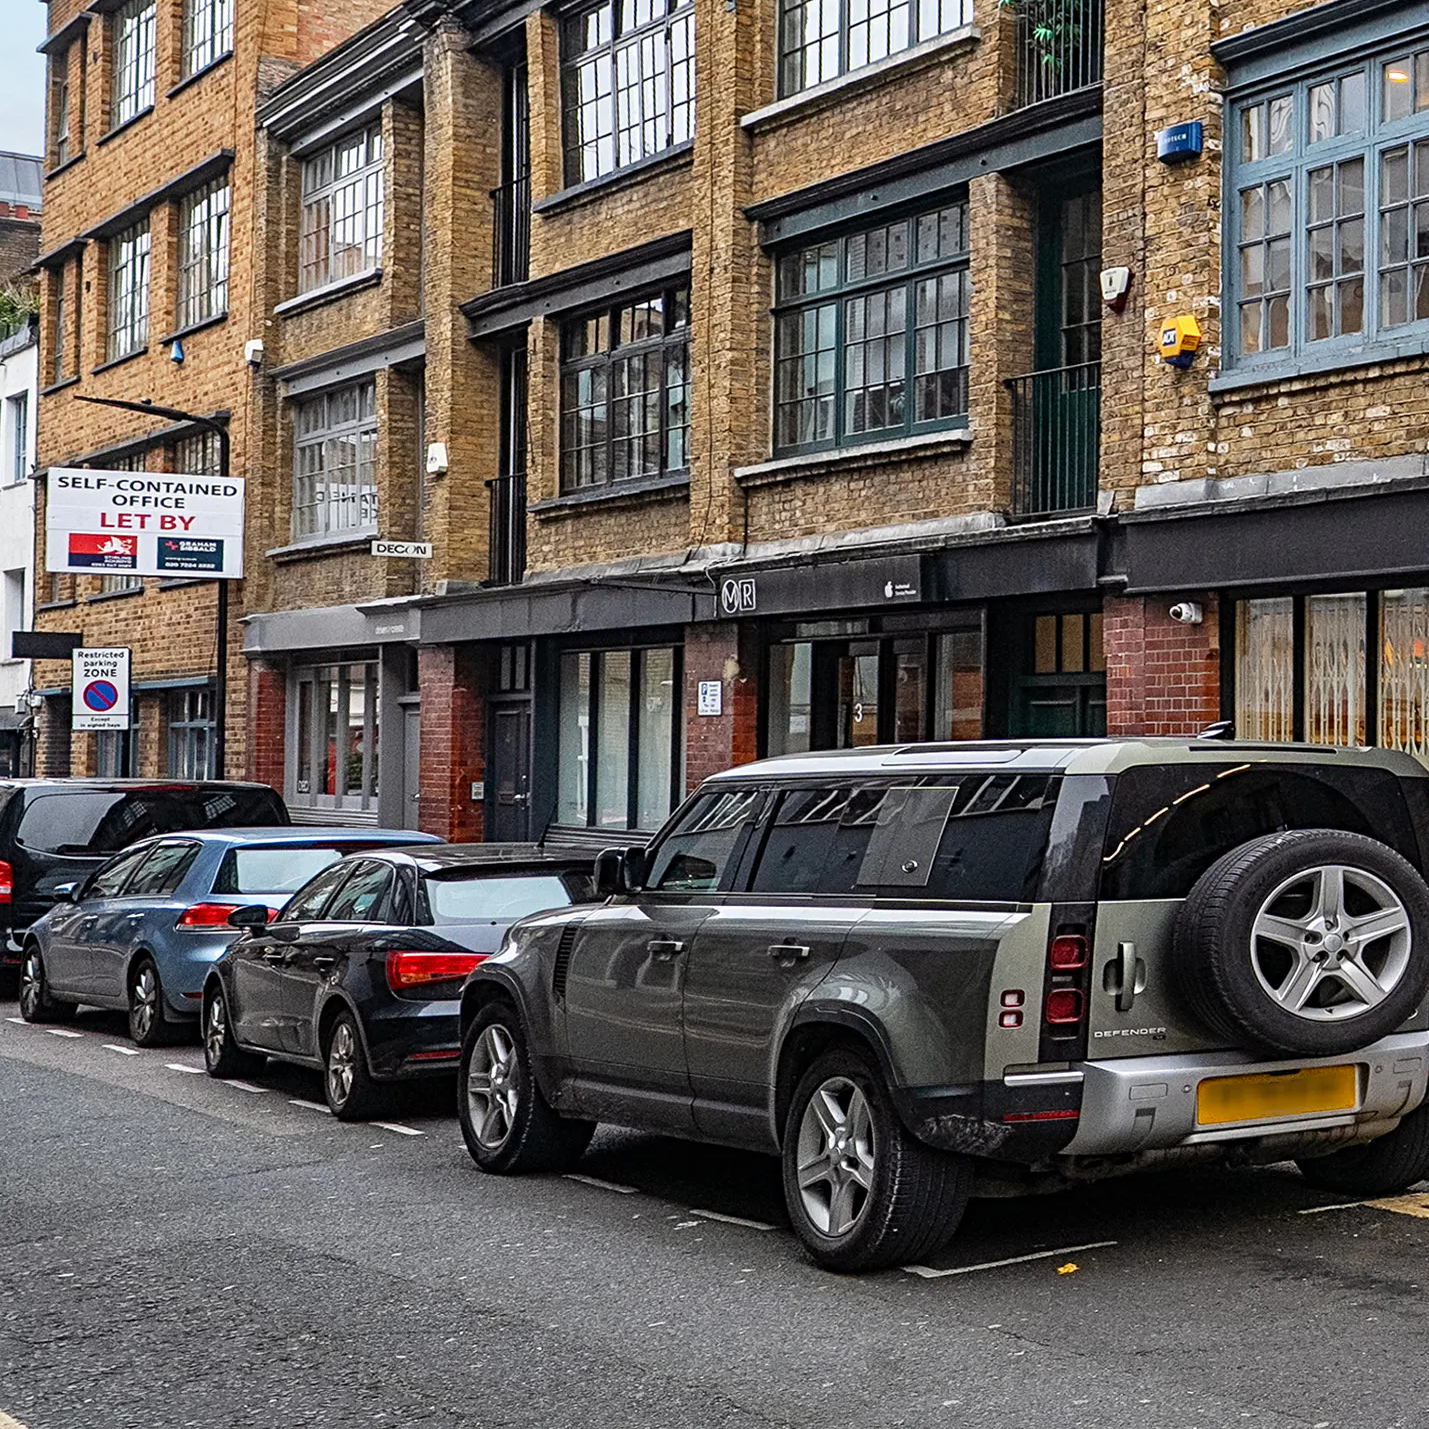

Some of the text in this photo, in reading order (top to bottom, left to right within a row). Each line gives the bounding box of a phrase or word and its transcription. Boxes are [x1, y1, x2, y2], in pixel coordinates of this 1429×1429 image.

[58, 476, 238, 497] SELF-CONTAINED
[112, 494, 185, 509] OFFICE
[100, 512, 196, 531] LET BY
[376, 543, 427, 555] DECON
[78, 651, 125, 659] Restricted
[84, 660, 118, 668] parking
[84, 669, 117, 677] ZONE
[855, 703, 862, 723] 3
[1094, 1027, 1167, 1038] DEFENDER
